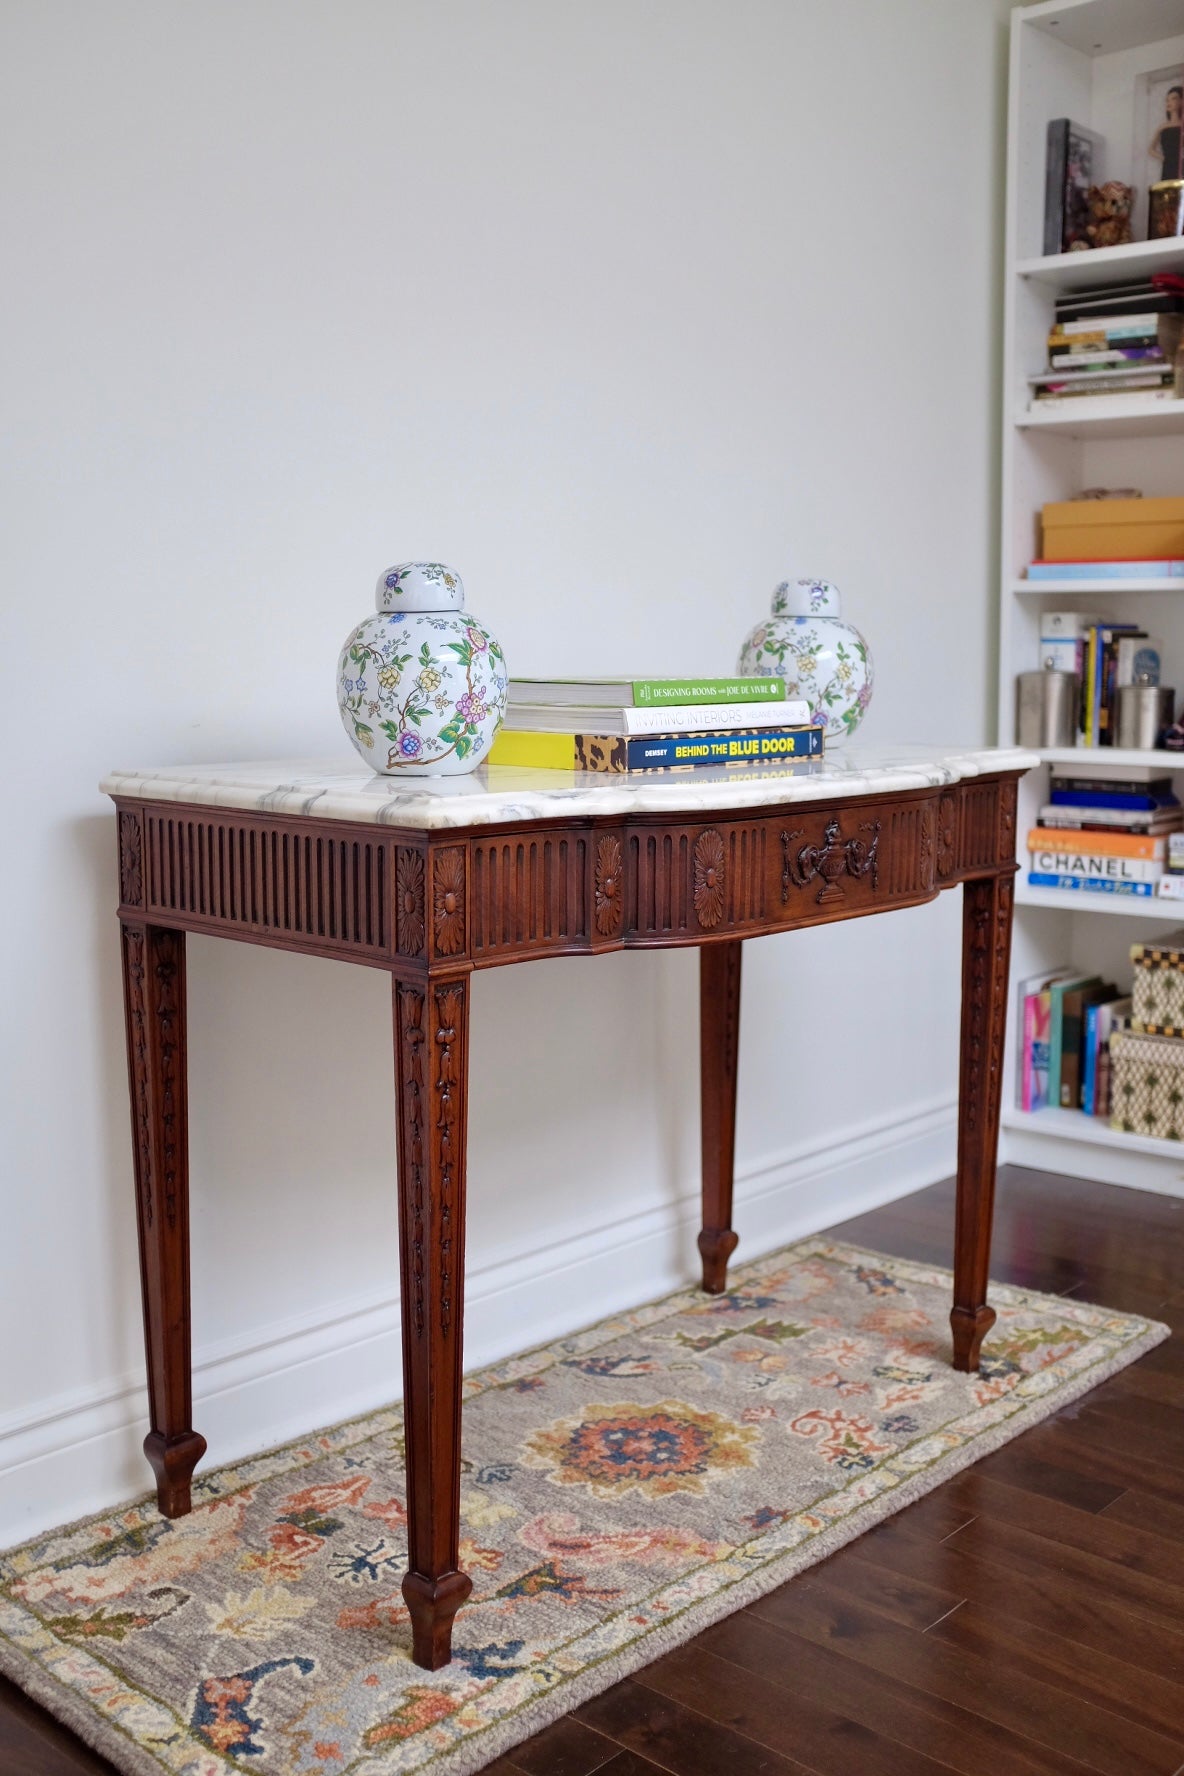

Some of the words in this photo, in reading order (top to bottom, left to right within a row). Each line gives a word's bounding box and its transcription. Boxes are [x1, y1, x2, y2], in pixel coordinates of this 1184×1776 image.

[653, 688, 691, 698] DESIGNING
[692, 687, 717, 696] ROOMS
[726, 686, 739, 697] JOIE
[741, 686, 750, 694] DE
[751, 685, 768, 694] VIVRE
[635, 712, 684, 727] INVITING
[687, 710, 742, 724] INTERIORS
[644, 748, 668, 757] DEMSEY
[675, 745, 709, 758] BEHIND
[711, 744, 728, 755] THE
[729, 740, 759, 756] BLUE
[761, 737, 795, 754] DOOR
[1039, 851, 1132, 878] CHANEL
